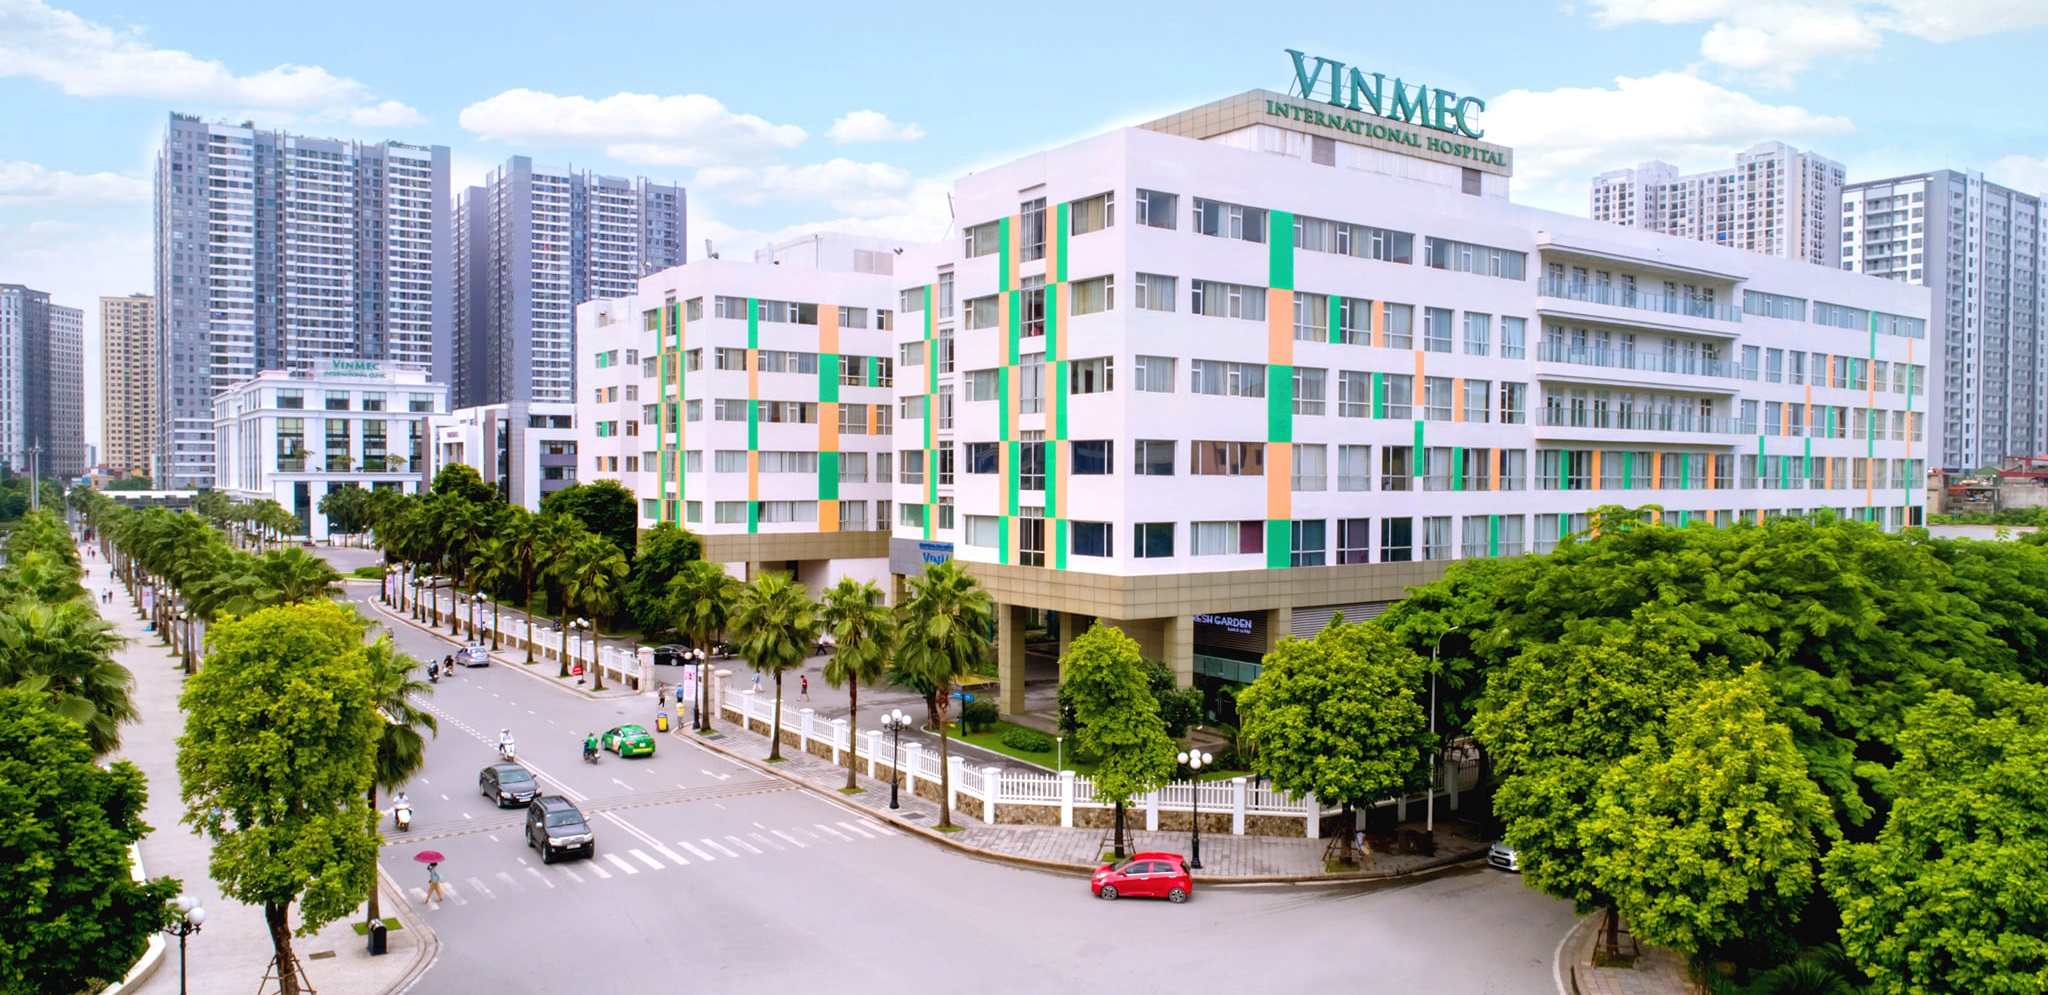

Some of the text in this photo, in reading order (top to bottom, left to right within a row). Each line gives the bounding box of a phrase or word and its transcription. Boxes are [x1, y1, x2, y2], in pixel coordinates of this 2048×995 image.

[1284, 48, 1486, 139] VINMEC
[1266, 99, 1507, 167] INTERNATIONAL HOSPITAL
[1214, 615, 1252, 629] GARDEN
